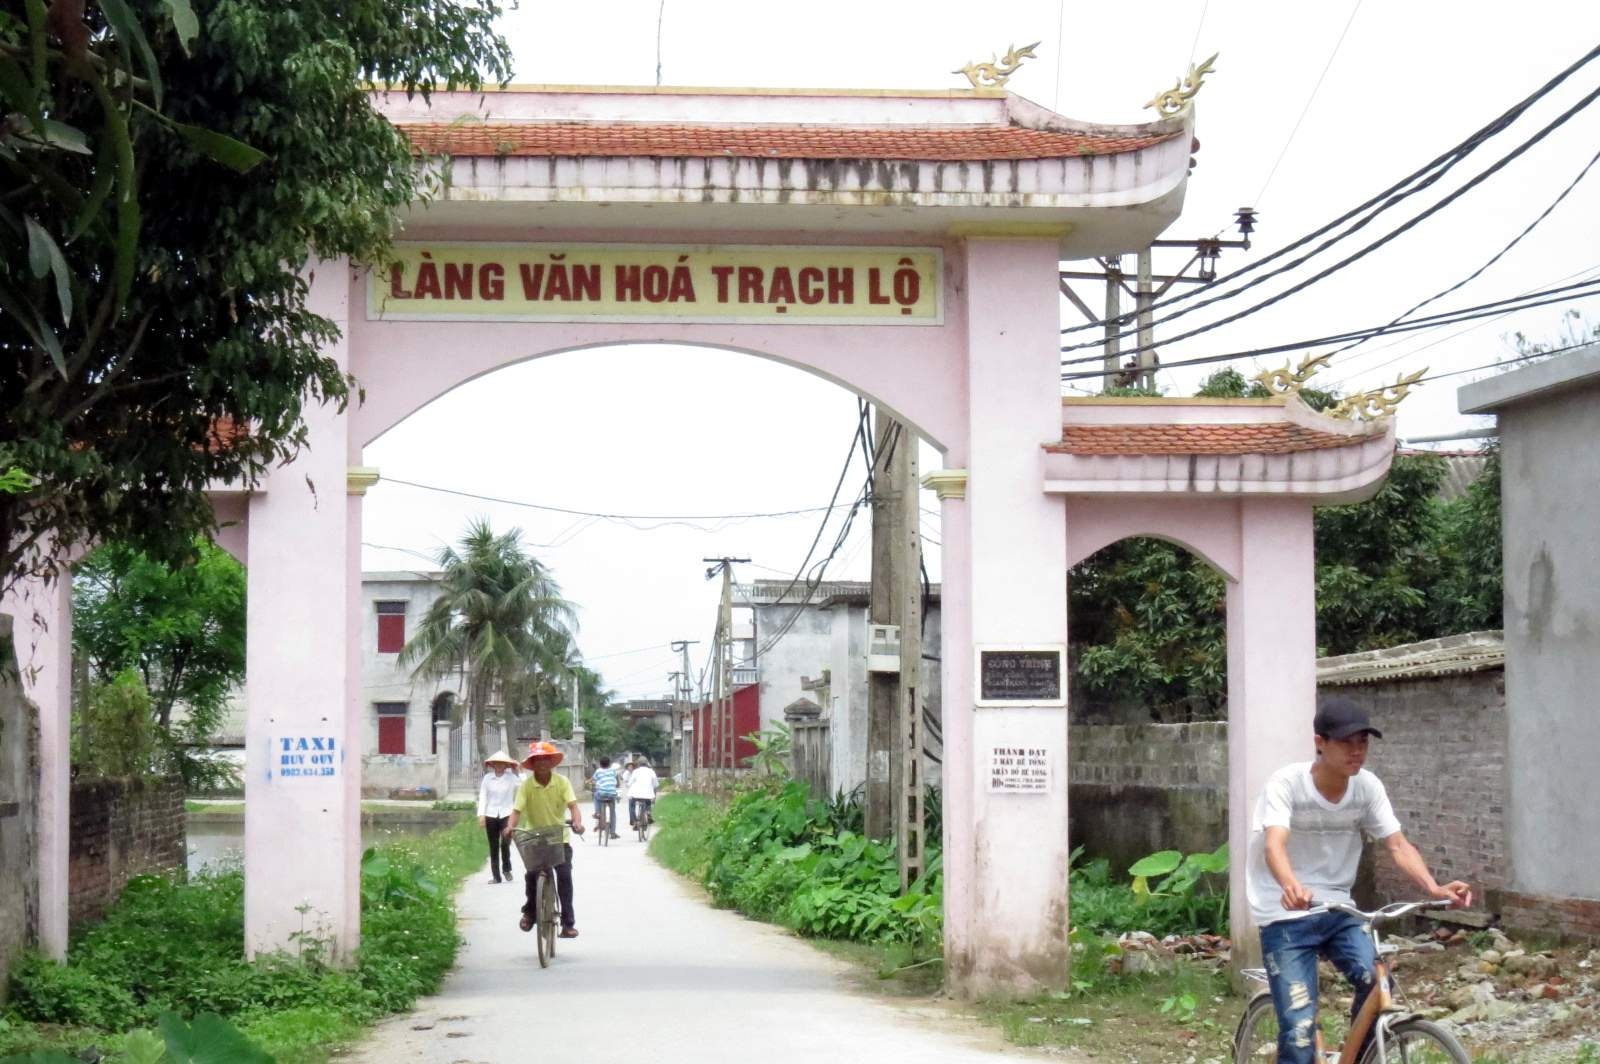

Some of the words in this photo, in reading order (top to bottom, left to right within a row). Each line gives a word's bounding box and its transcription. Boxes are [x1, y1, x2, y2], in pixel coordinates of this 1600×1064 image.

[390, 251, 505, 300] LÀNG
[519, 253, 602, 301] VĂN
[615, 255, 696, 303] HOÁ
[711, 265, 855, 313] TRẠCH
[868, 257, 920, 315] LỘ
[280, 737, 336, 751] TAXI
